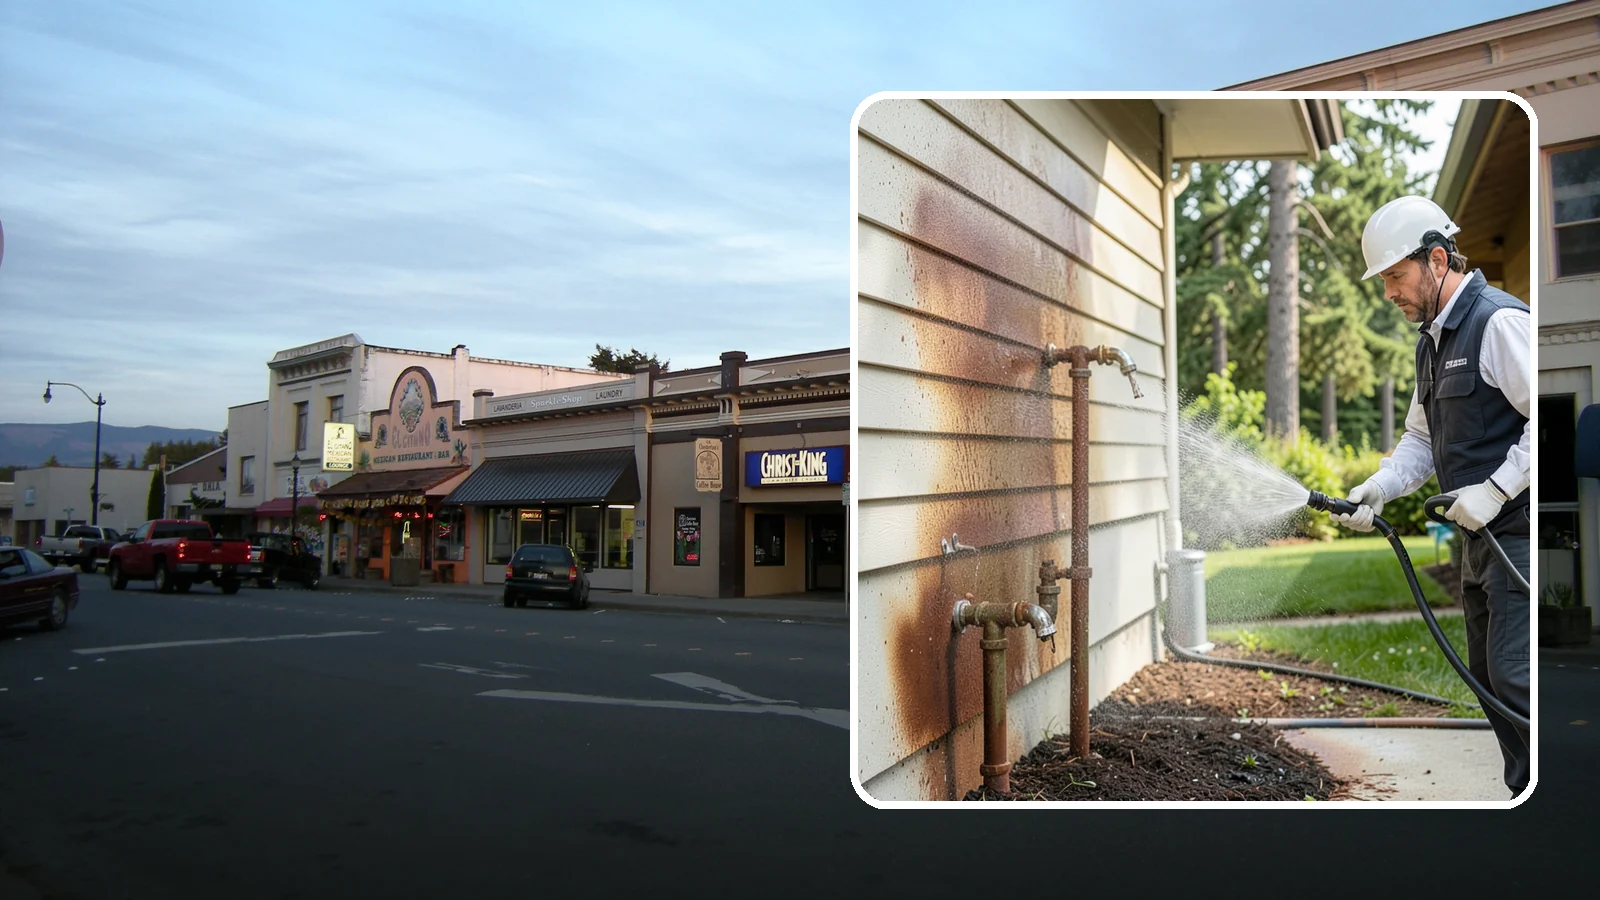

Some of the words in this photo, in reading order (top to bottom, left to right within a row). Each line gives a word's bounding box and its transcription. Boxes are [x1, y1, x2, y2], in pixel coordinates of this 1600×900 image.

[595, 388, 623, 400] LAUNDRY
[493, 402, 523, 413] LAVANDERIA
[531, 397, 560, 409] Sparkle
[561, 394, 583, 405] Shop
[374, 455, 396, 464] MEXICAN
[398, 452, 433, 462] RESTAURANT
[437, 450, 450, 459] BAR
[761, 453, 796, 477] CHRIST
[799, 450, 827, 475] KING
